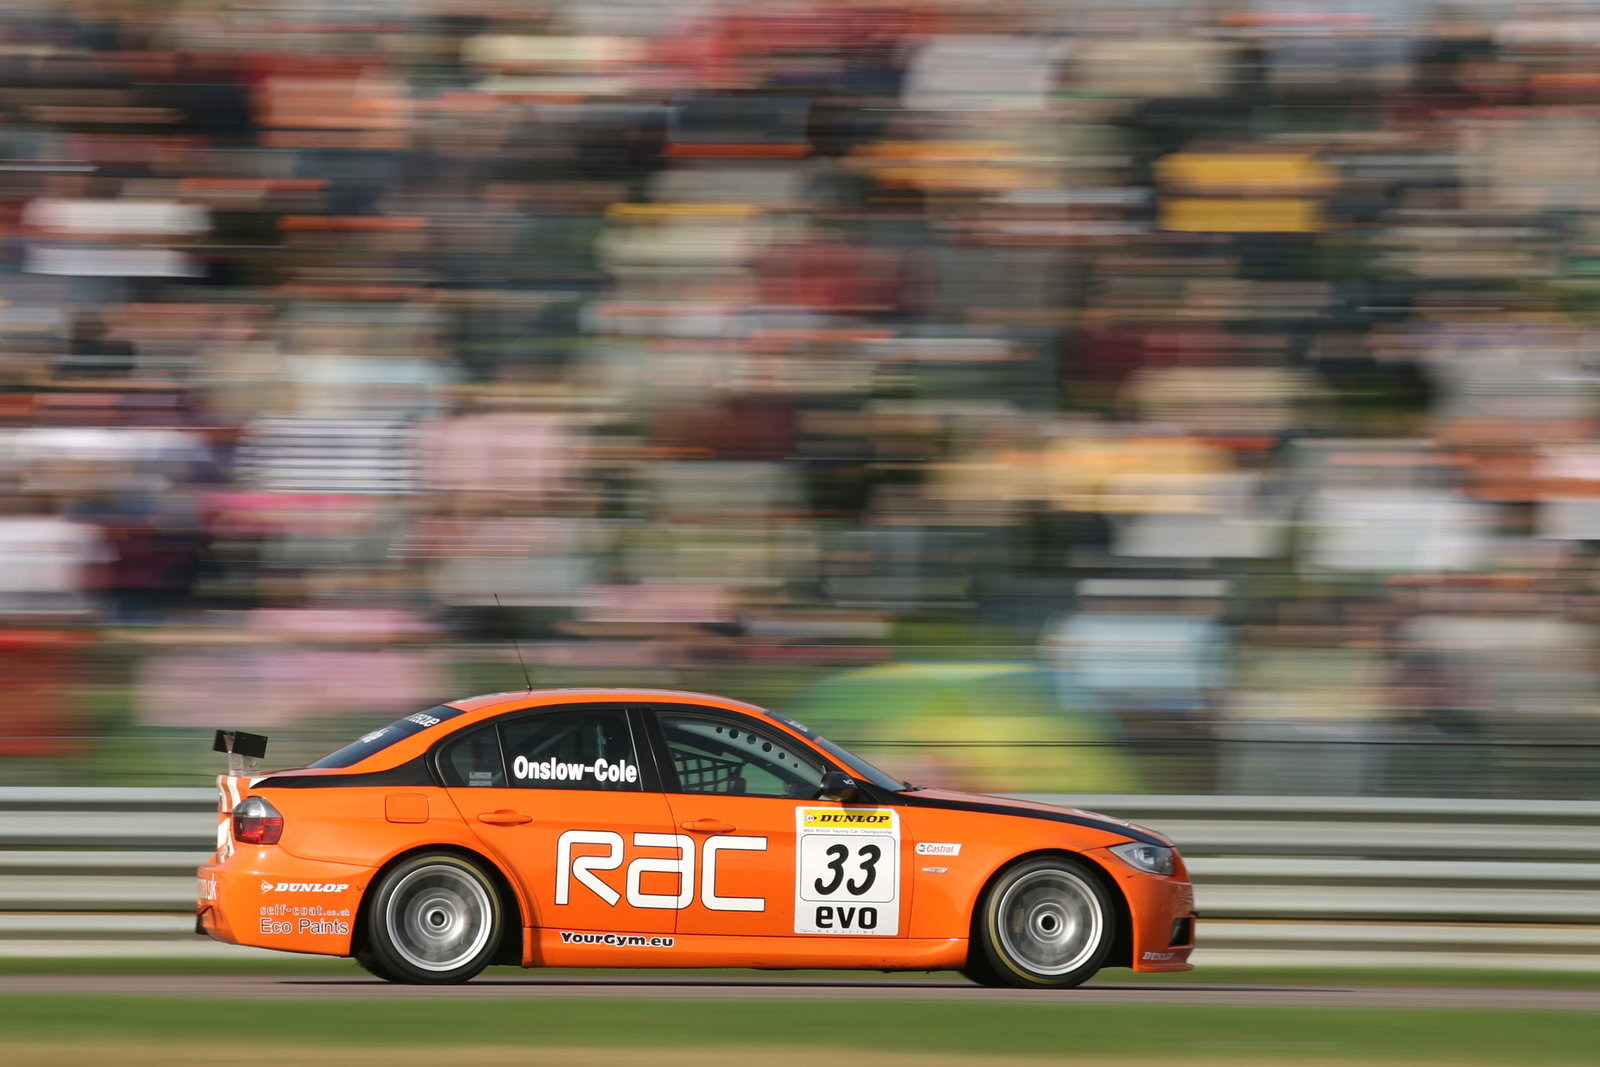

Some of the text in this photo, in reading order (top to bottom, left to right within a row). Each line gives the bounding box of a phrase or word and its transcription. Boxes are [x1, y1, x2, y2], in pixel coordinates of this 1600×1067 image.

[513, 755, 638, 783] Onslow-Cole
[820, 814, 890, 823] DUNLOP
[926, 844, 954, 853] Castrol
[814, 843, 881, 896] 33
[274, 882, 349, 893] DUNLOP
[259, 904, 351, 917] self-coat.co.uk
[815, 906, 878, 930] evo
[260, 917, 350, 935] Eco Paints
[560, 931, 675, 948] YourGym.eu
